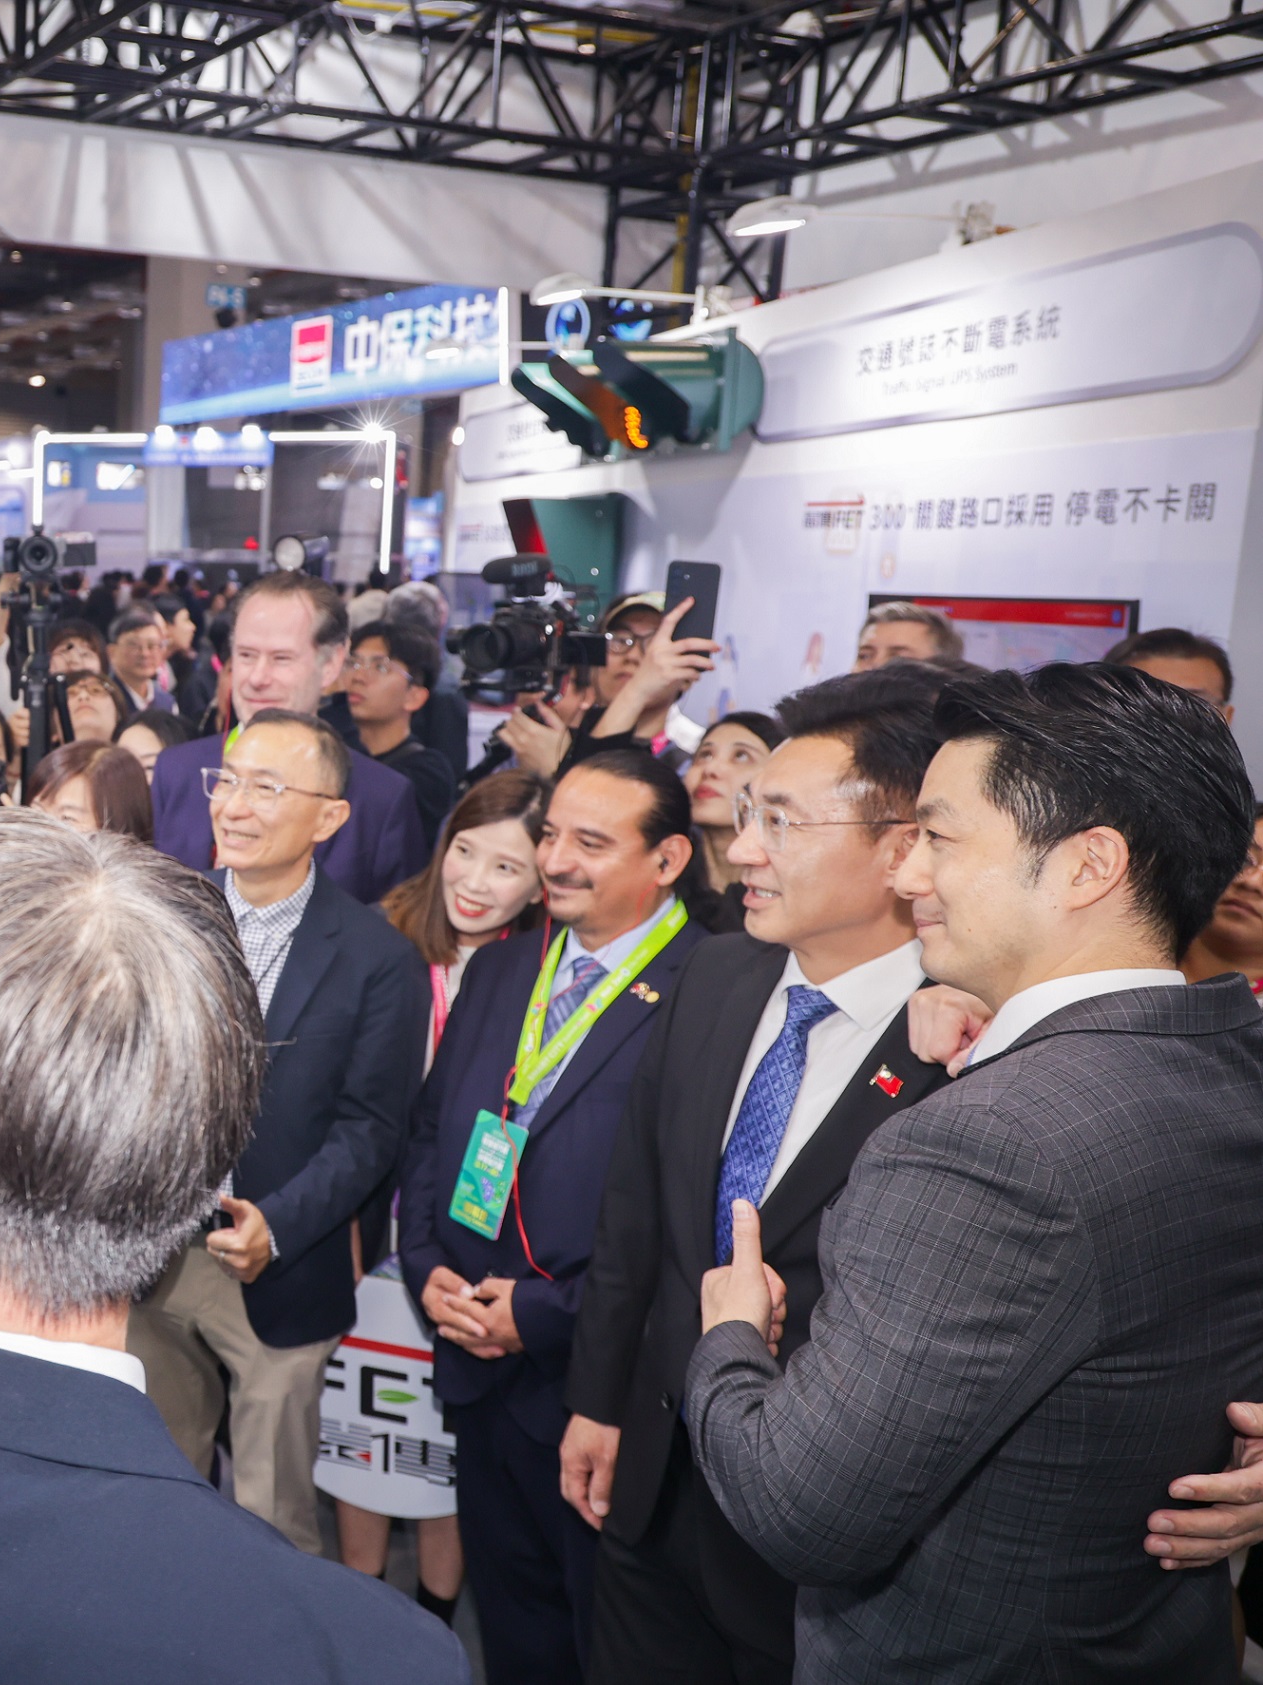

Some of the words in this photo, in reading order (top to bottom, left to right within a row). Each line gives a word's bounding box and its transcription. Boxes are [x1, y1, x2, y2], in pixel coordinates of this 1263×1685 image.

[1066, 482, 1218, 526] 停電不卡關
